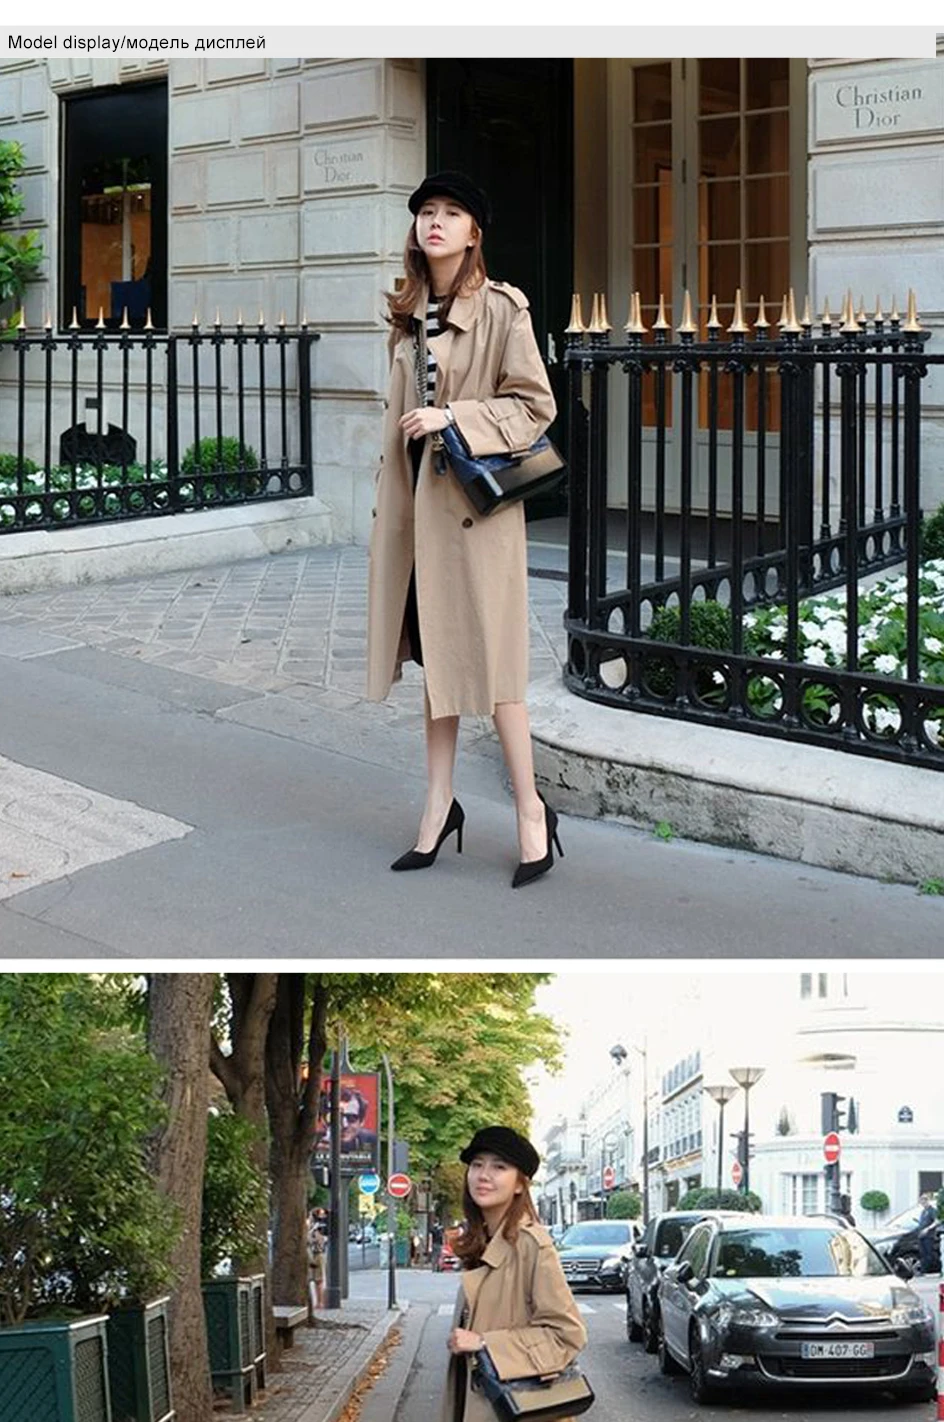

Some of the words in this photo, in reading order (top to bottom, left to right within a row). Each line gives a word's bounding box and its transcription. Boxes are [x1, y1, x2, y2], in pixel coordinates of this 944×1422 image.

[836, 85, 922, 107] Christian
[855, 107, 901, 129] Dior
[324, 166, 351, 184] Dior
